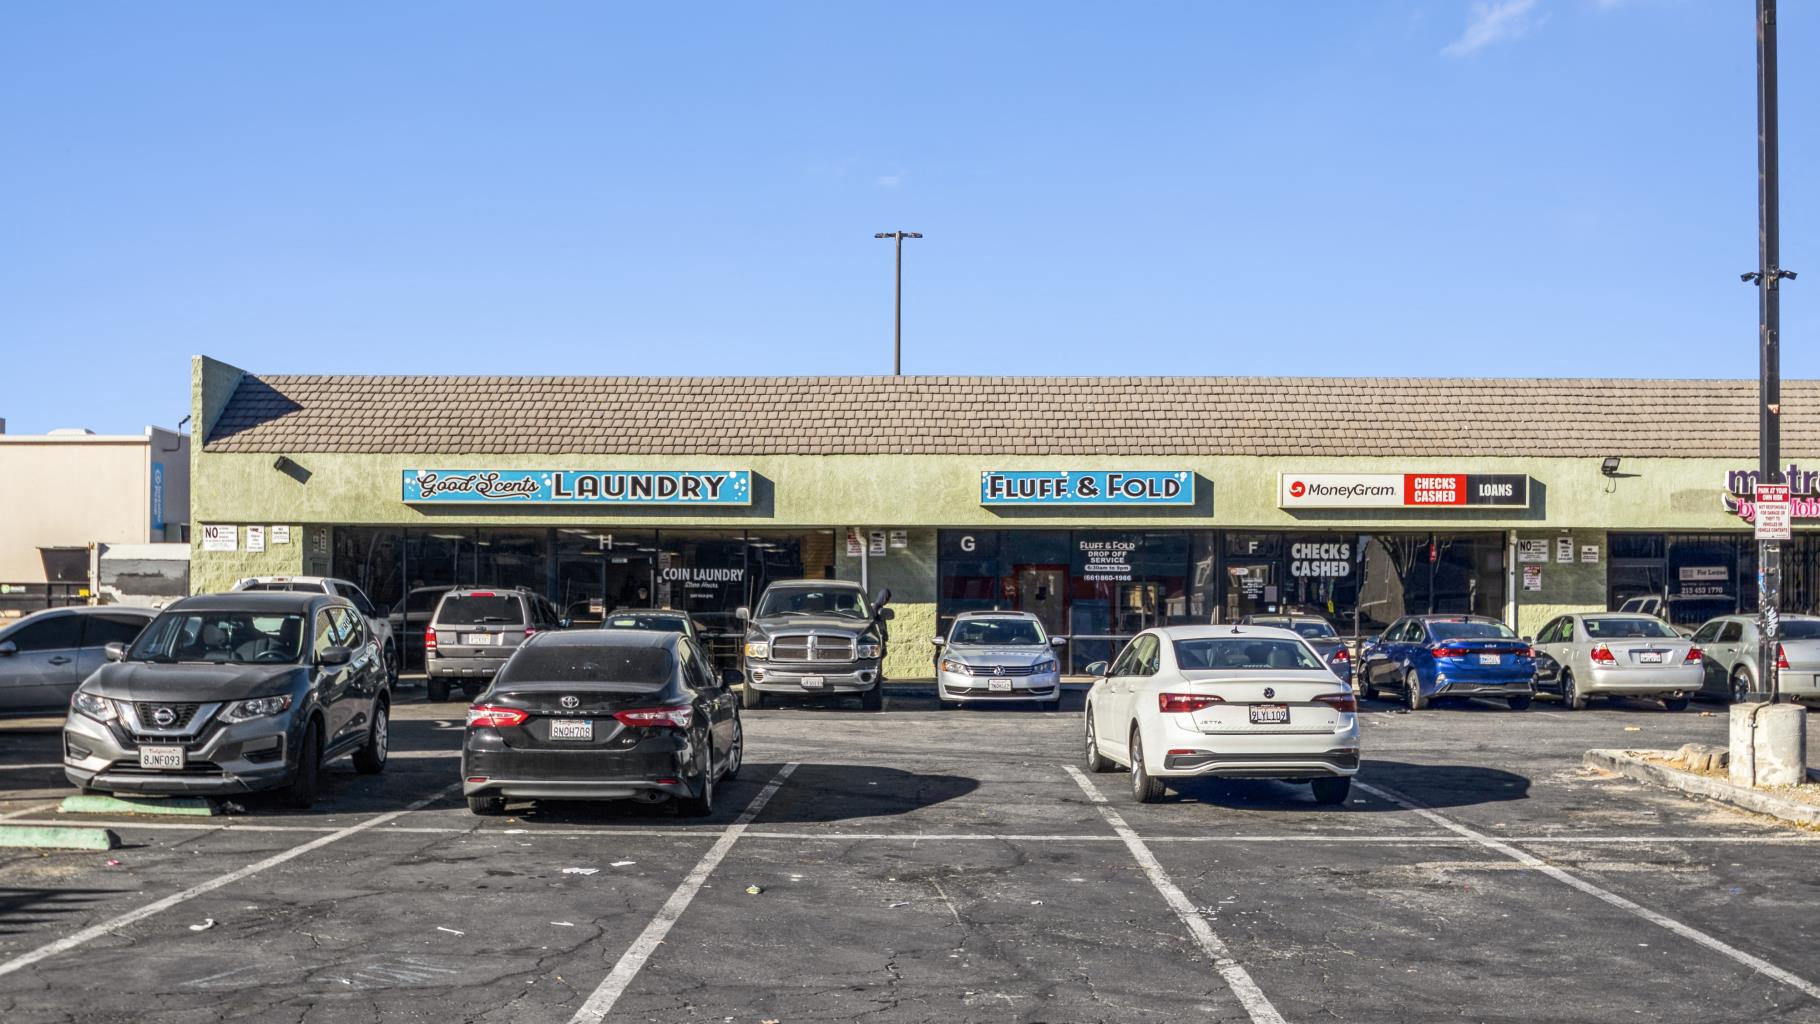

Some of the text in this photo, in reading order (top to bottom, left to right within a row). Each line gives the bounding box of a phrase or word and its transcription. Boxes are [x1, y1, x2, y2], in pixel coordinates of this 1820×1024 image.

[417, 472, 727, 499] Good Scents LAUNDRY
[990, 474, 1181, 498] FLUFF & FOLD
[1414, 477, 1456, 490] CHECKS
[1479, 483, 1513, 497] LOANS
[1308, 483, 1395, 499] MoneyGram
[1414, 490, 1456, 503] CASHED
[205, 526, 219, 539] NO
[600, 534, 612, 550] H
[960, 536, 976, 552] G
[1080, 541, 1104, 549] FLUFF
[1113, 541, 1135, 549] FOLD
[1248, 541, 1259, 554] F
[1520, 541, 1532, 552] NO
[1291, 543, 1350, 559] CHECKS
[662, 568, 744, 582] COIN LAUNDRY
[1291, 561, 1350, 577] CASHED
[143, 754, 181, 766] 8JNF093
